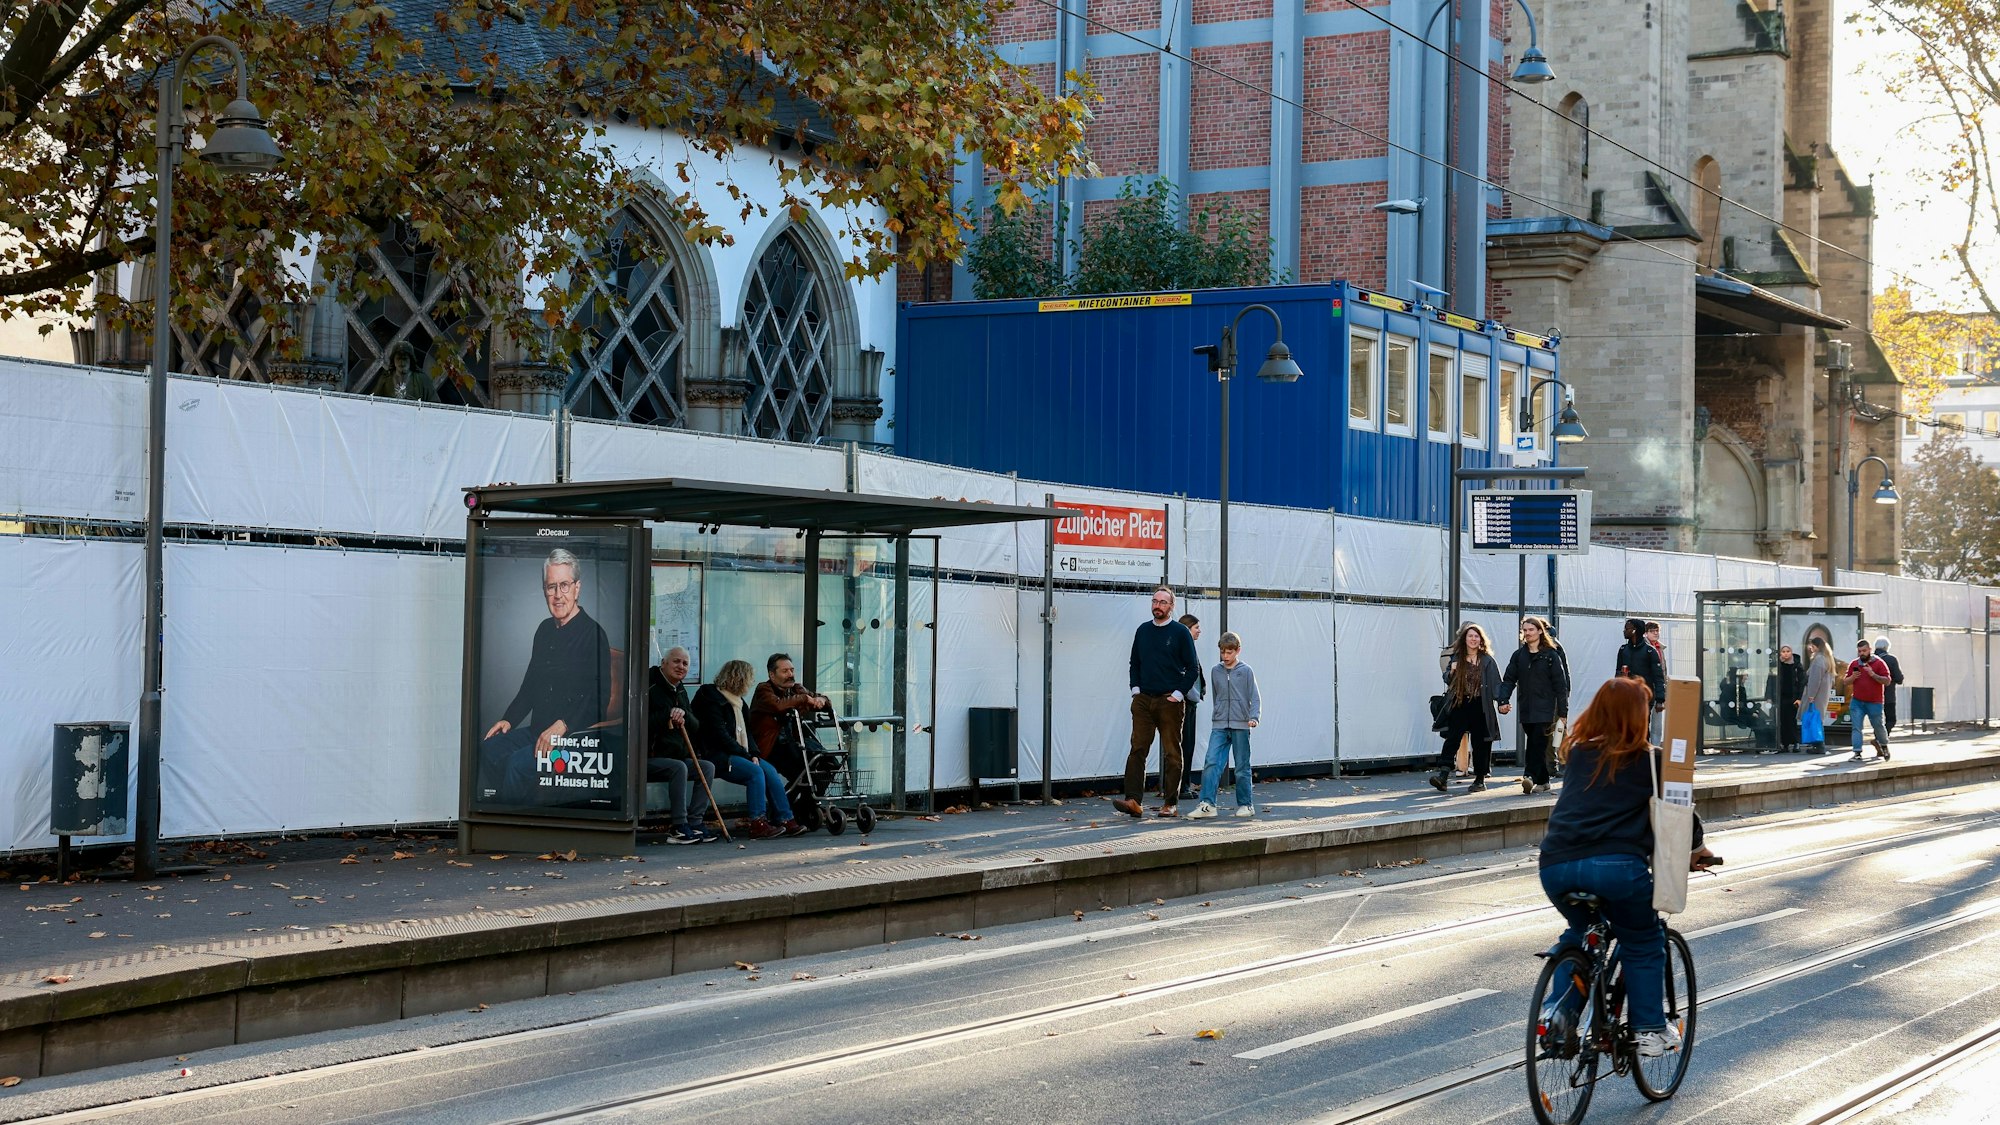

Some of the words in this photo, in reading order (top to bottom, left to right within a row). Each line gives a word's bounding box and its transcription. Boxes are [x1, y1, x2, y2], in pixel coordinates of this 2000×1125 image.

[1077, 296, 1151, 309] MIETCONTAINER
[536, 528, 570, 536] JCDecaux
[1129, 512, 1163, 539] Platz
[1070, 558, 1076, 571] 9
[550, 734, 580, 748] Einer,
[581, 735, 600, 748] der
[539, 777, 552, 786] zu
[555, 775, 588, 788] Hause
[590, 776, 609, 789] hat
